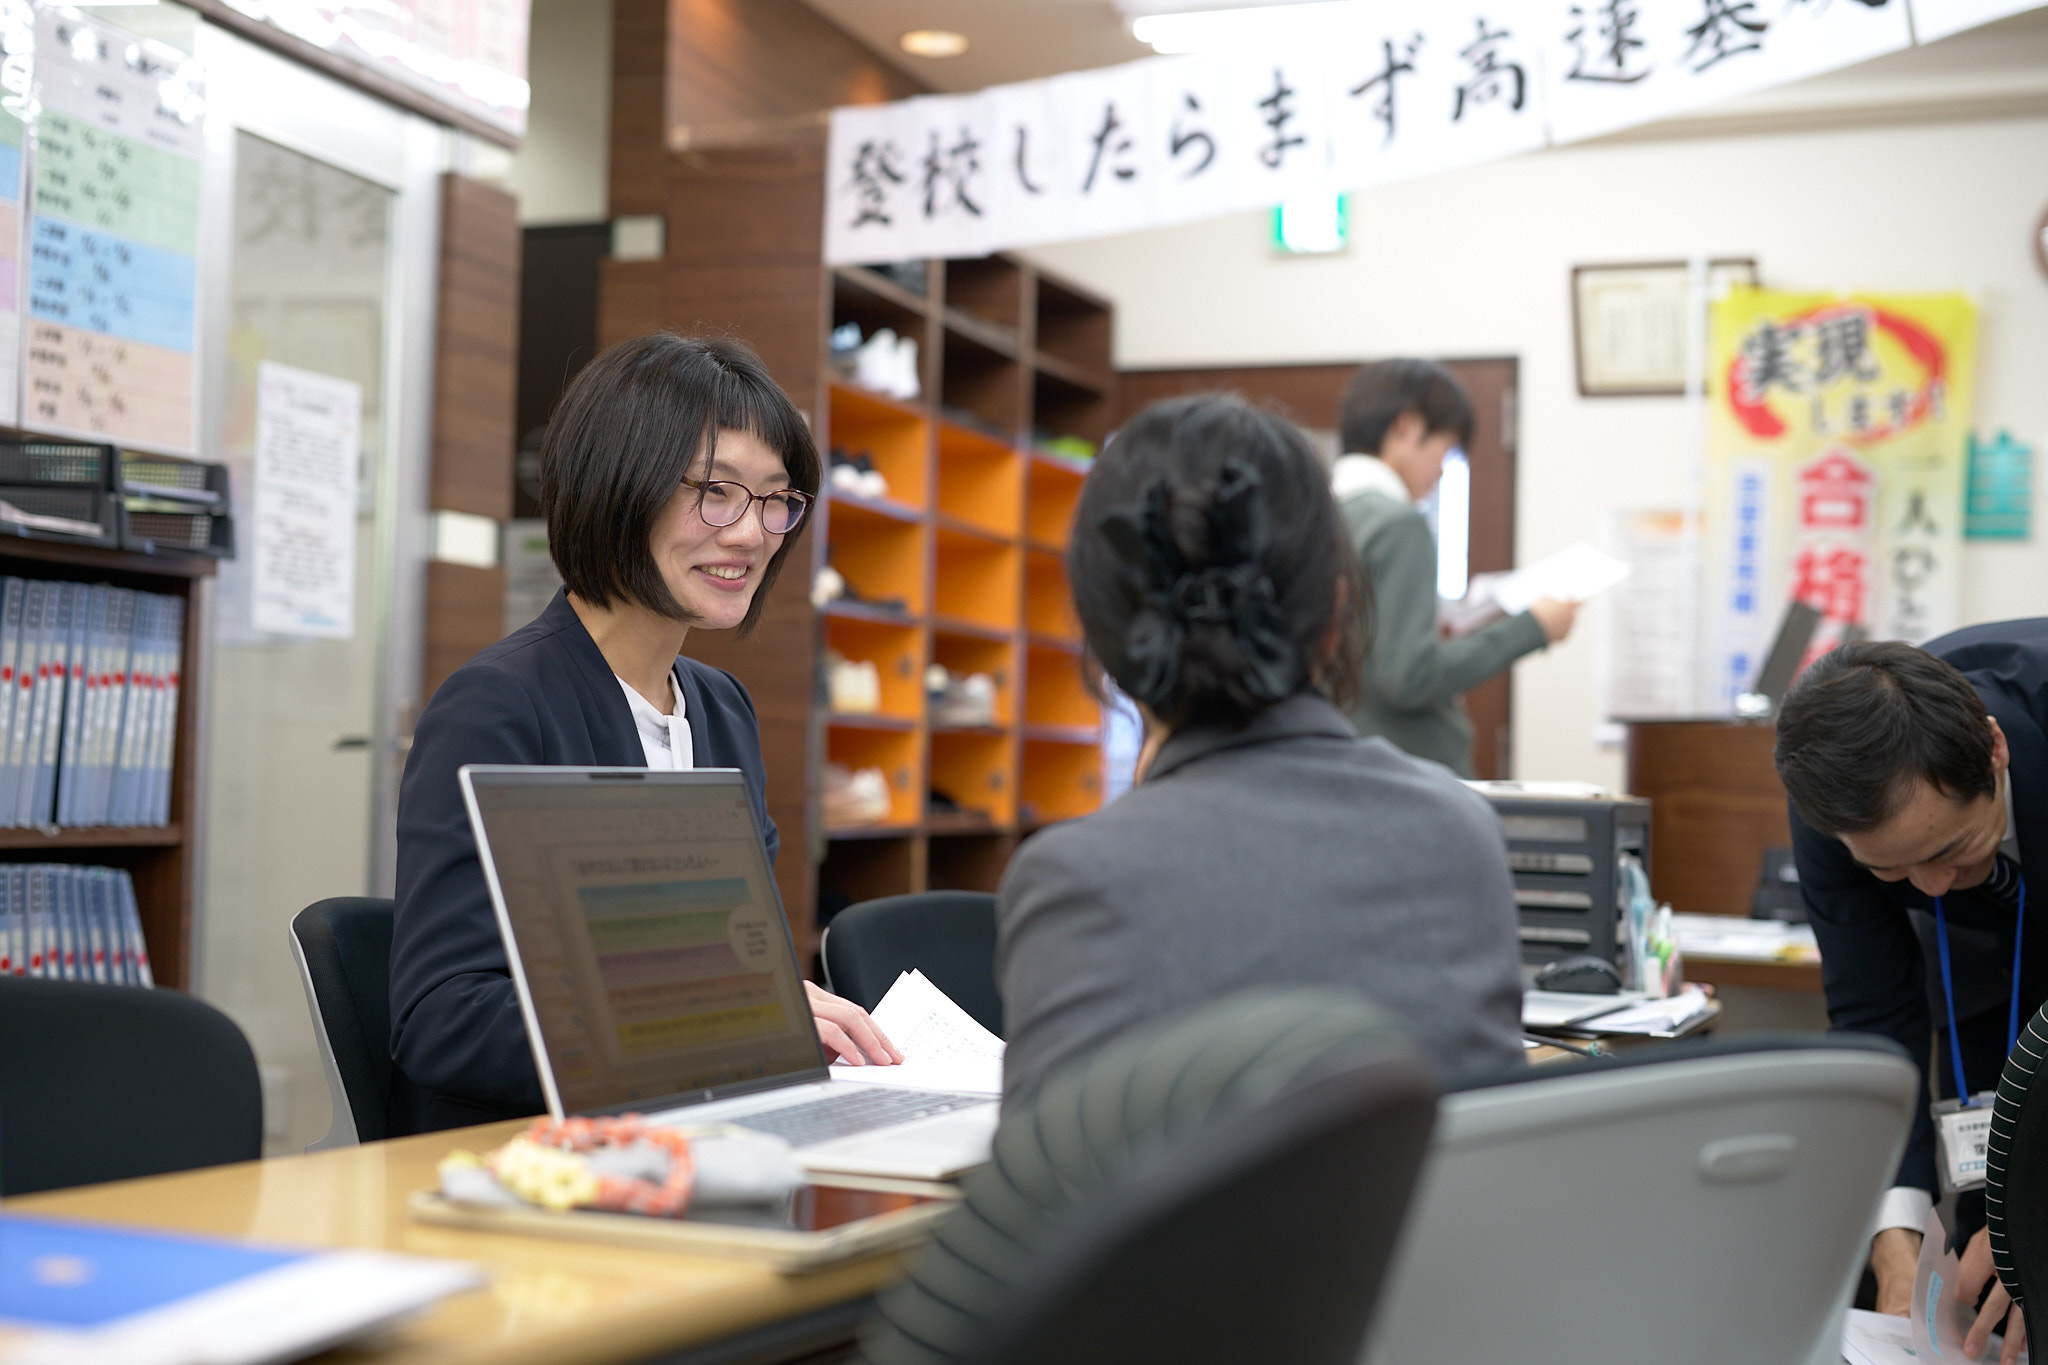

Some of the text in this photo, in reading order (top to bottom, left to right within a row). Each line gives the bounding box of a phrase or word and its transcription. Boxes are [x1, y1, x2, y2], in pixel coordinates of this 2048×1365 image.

[843, 0, 1890, 229] 登校したらまず高速基
[1740, 311, 1878, 402] 実現
